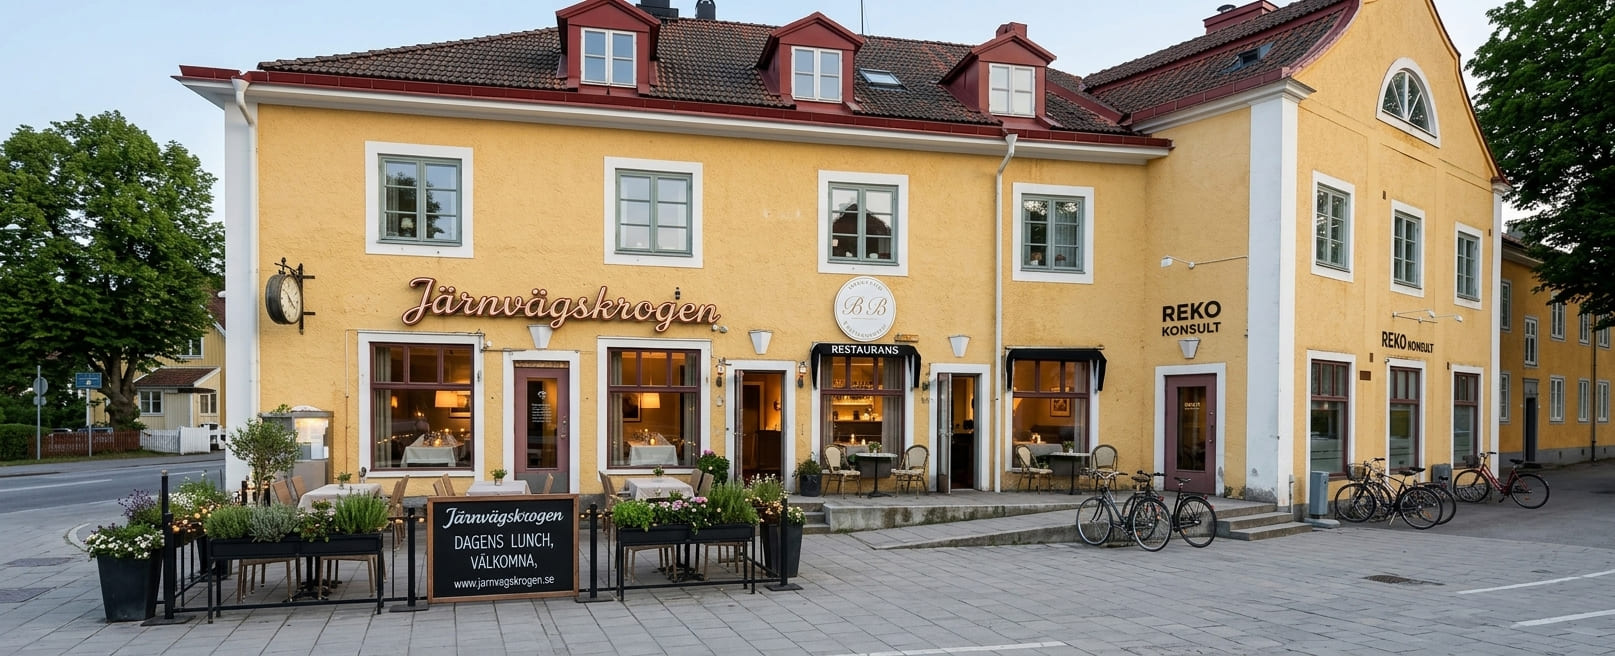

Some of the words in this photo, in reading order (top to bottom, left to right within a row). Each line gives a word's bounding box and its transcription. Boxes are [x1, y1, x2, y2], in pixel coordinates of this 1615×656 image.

[402, 276, 721, 332] Järnvägskrogen
[1162, 300, 1222, 322] REKO
[1161, 322, 1221, 337] KONSULT
[1381, 331, 1407, 350] REKO
[831, 345, 899, 355] RESTAURANS
[454, 534, 504, 550] DAGENS
[511, 532, 554, 549] LUNCH,
[470, 553, 538, 570] VÄLKOMNA,
